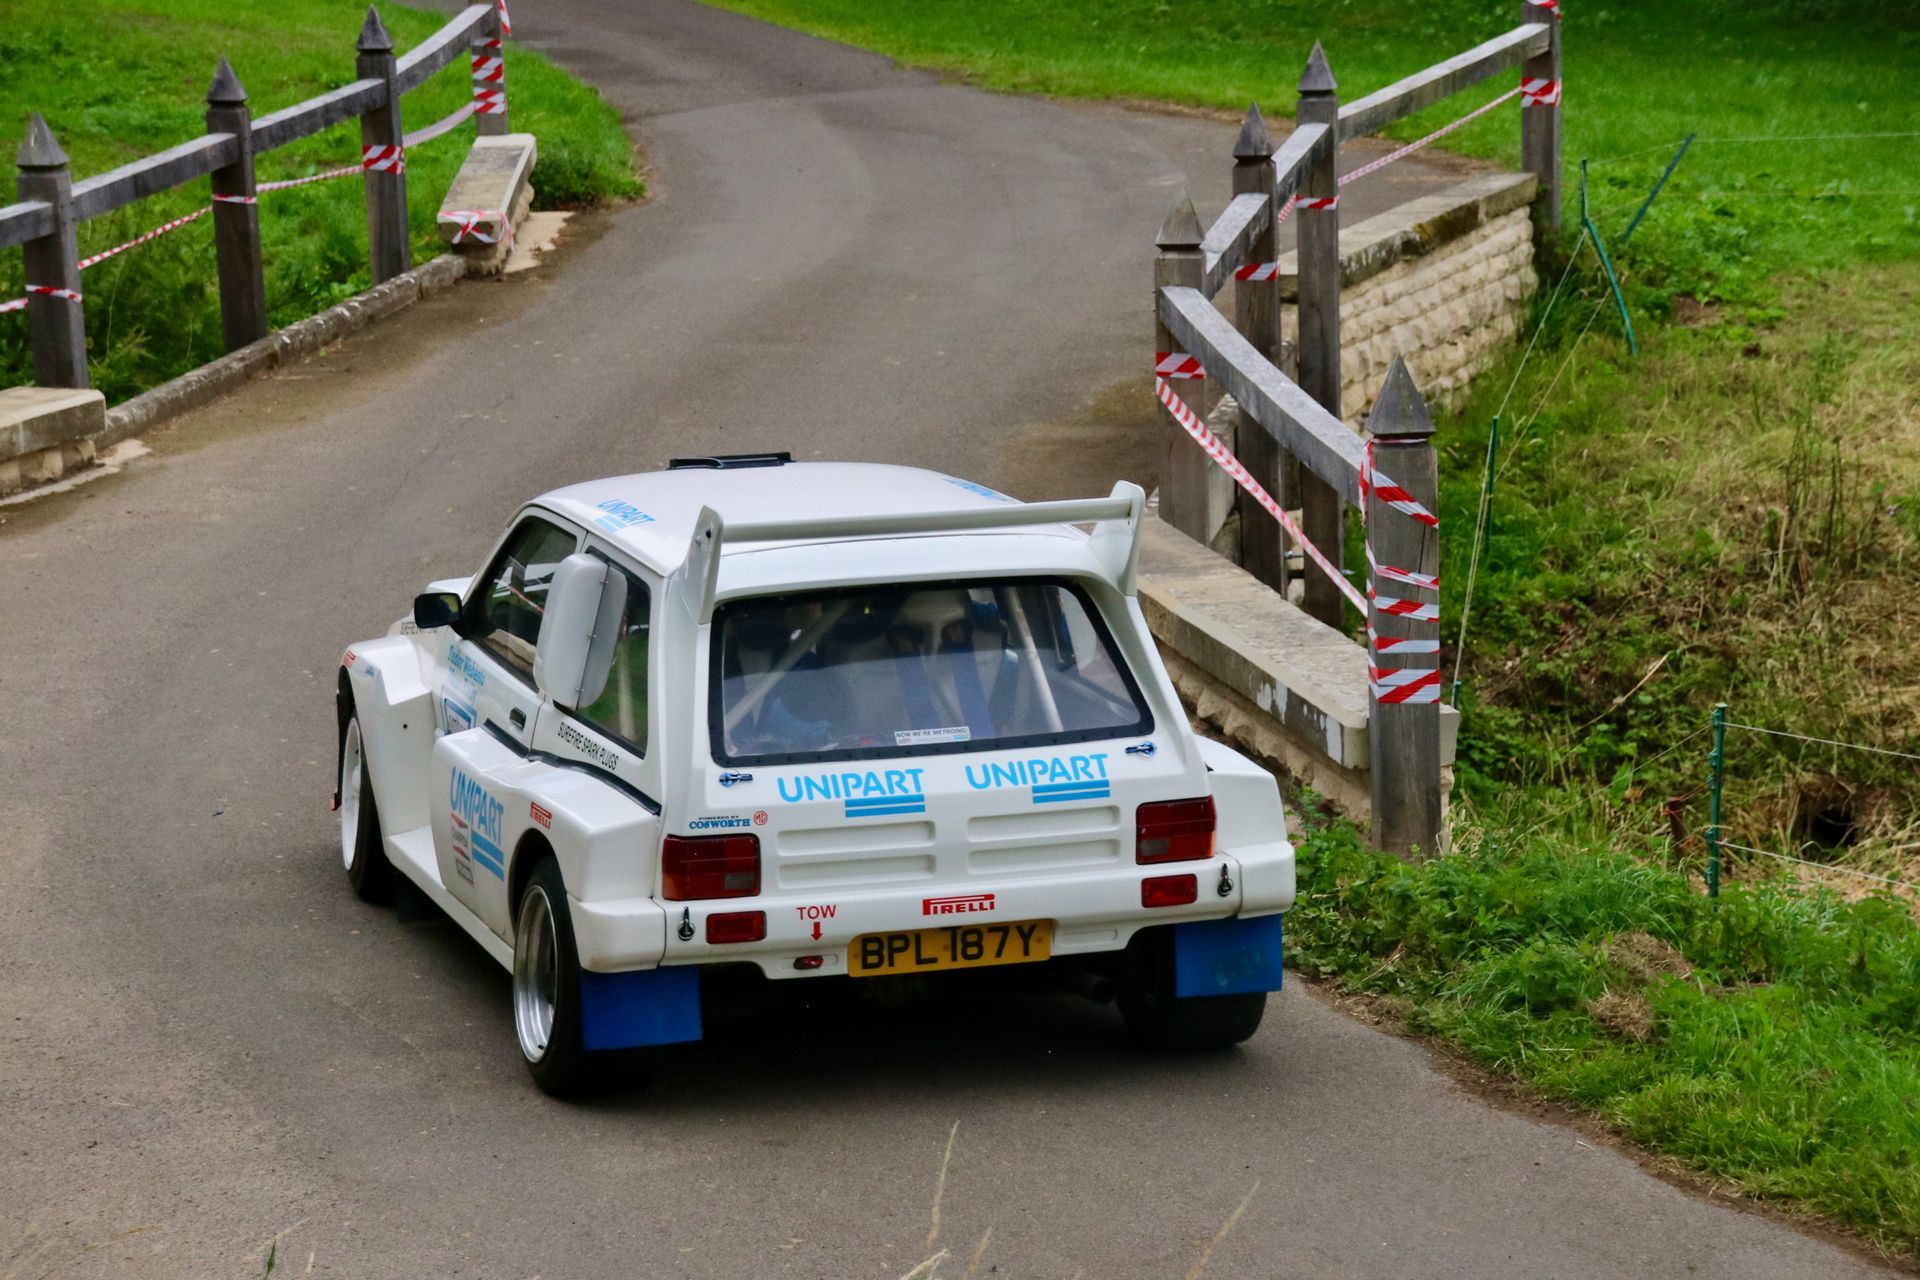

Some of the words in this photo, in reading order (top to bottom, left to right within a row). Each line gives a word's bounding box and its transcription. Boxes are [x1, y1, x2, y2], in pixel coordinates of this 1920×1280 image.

[597, 499, 656, 526] UNIPART
[558, 721, 584, 750] SUREFIRE
[582, 737, 602, 761] SPARK
[600, 747, 619, 771] PLUGS
[777, 768, 924, 803] UNIPART
[964, 753, 1108, 790] UNIPART
[449, 766, 505, 847] UNIPART
[530, 800, 553, 829] PIRELLI
[689, 818, 751, 829] COSWORTH
[796, 904, 837, 920] TOW
[922, 893, 995, 916] PIRELLI
[861, 933, 938, 969] BPL
